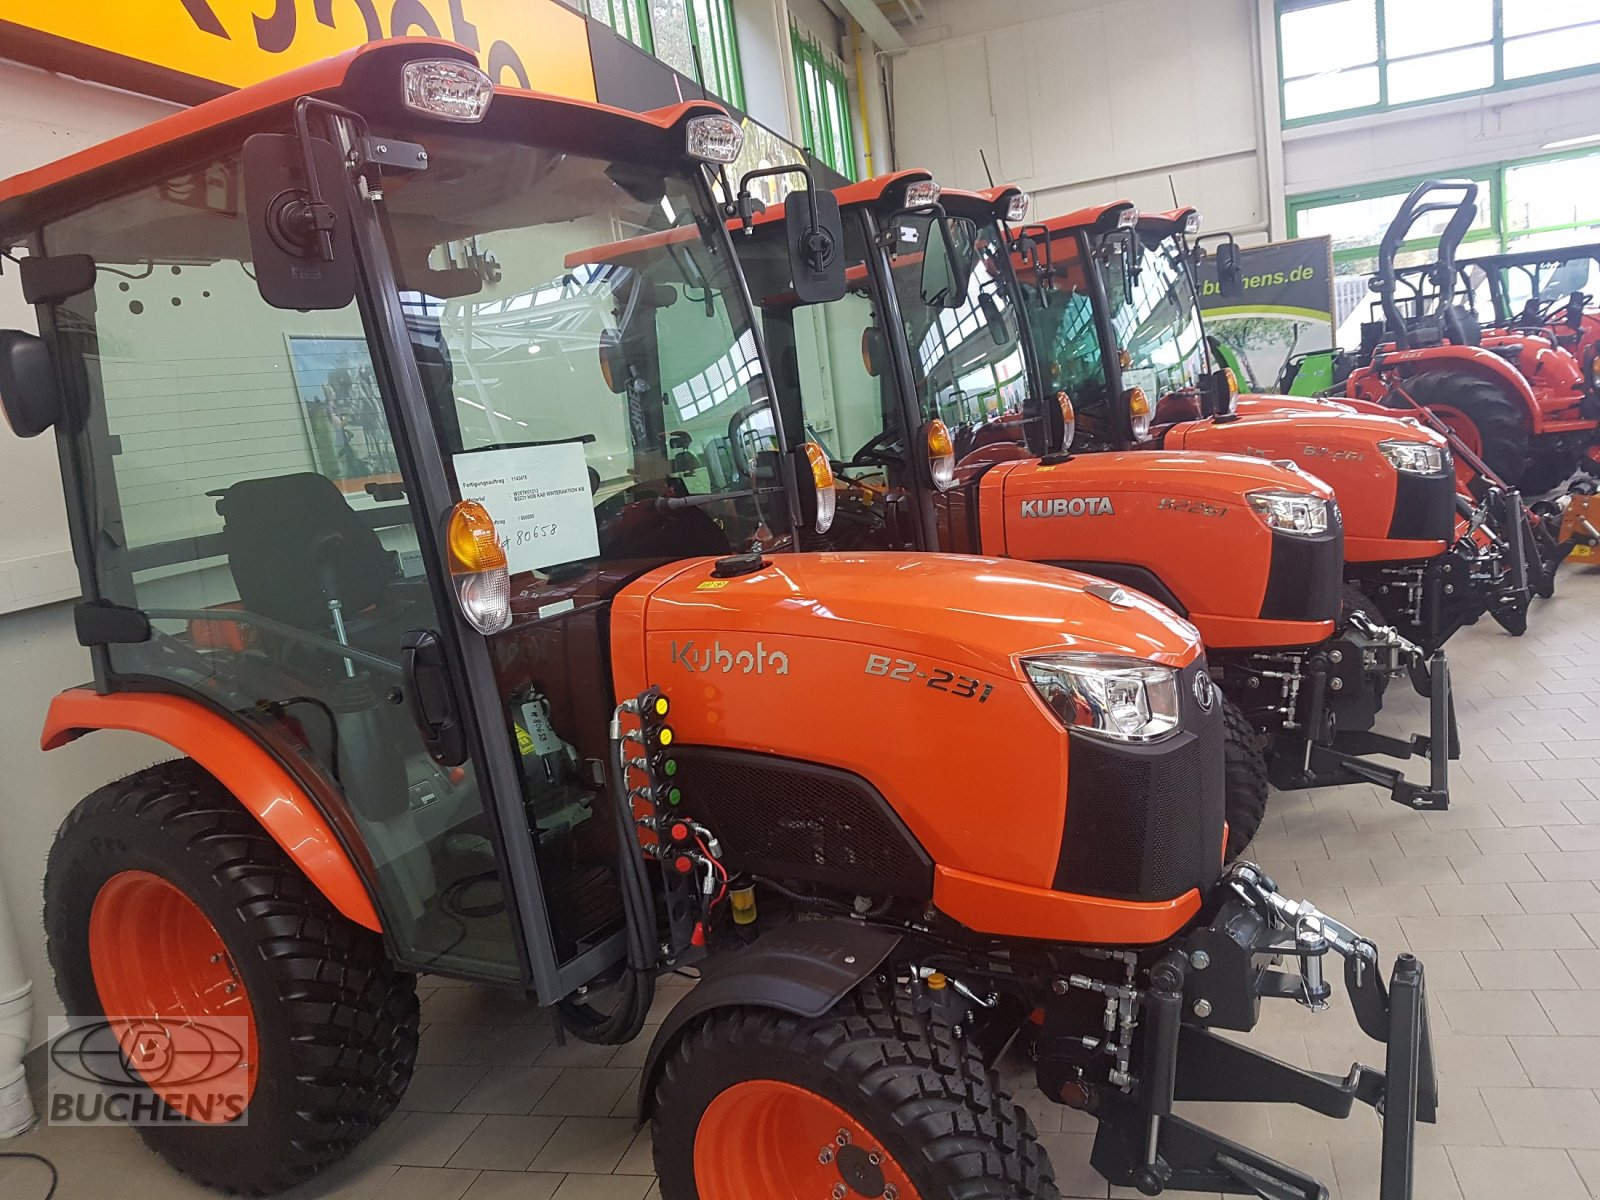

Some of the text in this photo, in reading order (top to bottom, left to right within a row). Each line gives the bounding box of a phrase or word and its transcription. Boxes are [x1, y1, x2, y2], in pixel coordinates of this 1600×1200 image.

[1021, 496, 1115, 519] KUBOTA
[516, 523, 558, 546] 80658
[671, 640, 789, 676] Kubota
[864, 653, 996, 704] B2-231
